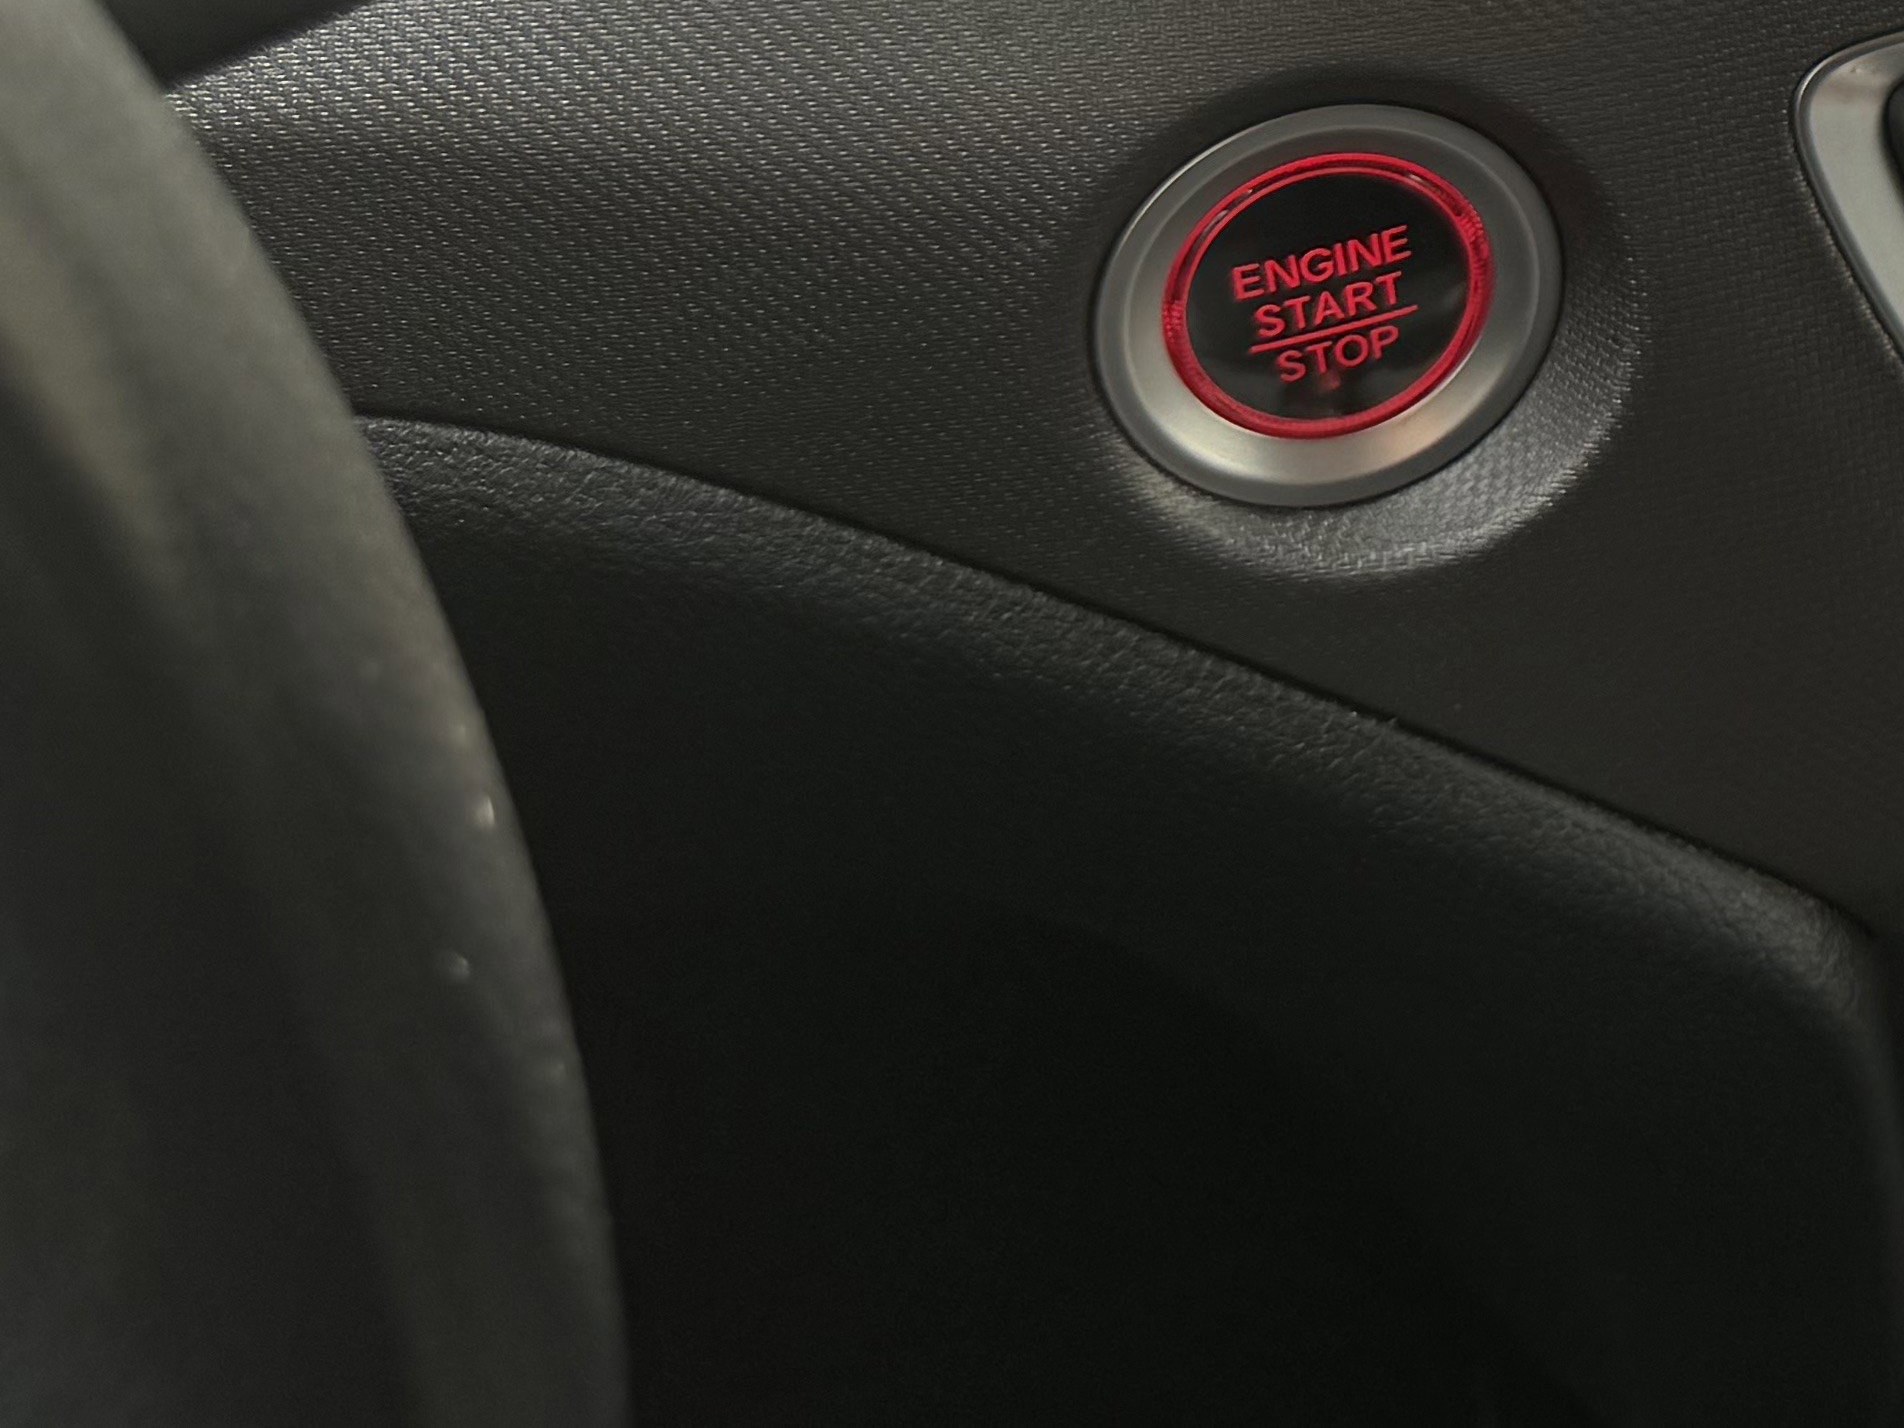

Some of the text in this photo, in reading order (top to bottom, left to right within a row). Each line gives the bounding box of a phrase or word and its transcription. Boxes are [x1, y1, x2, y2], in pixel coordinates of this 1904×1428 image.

[1231, 224, 1413, 300] ENGINE
[1254, 271, 1402, 338] START
[1275, 324, 1400, 382] STOP
